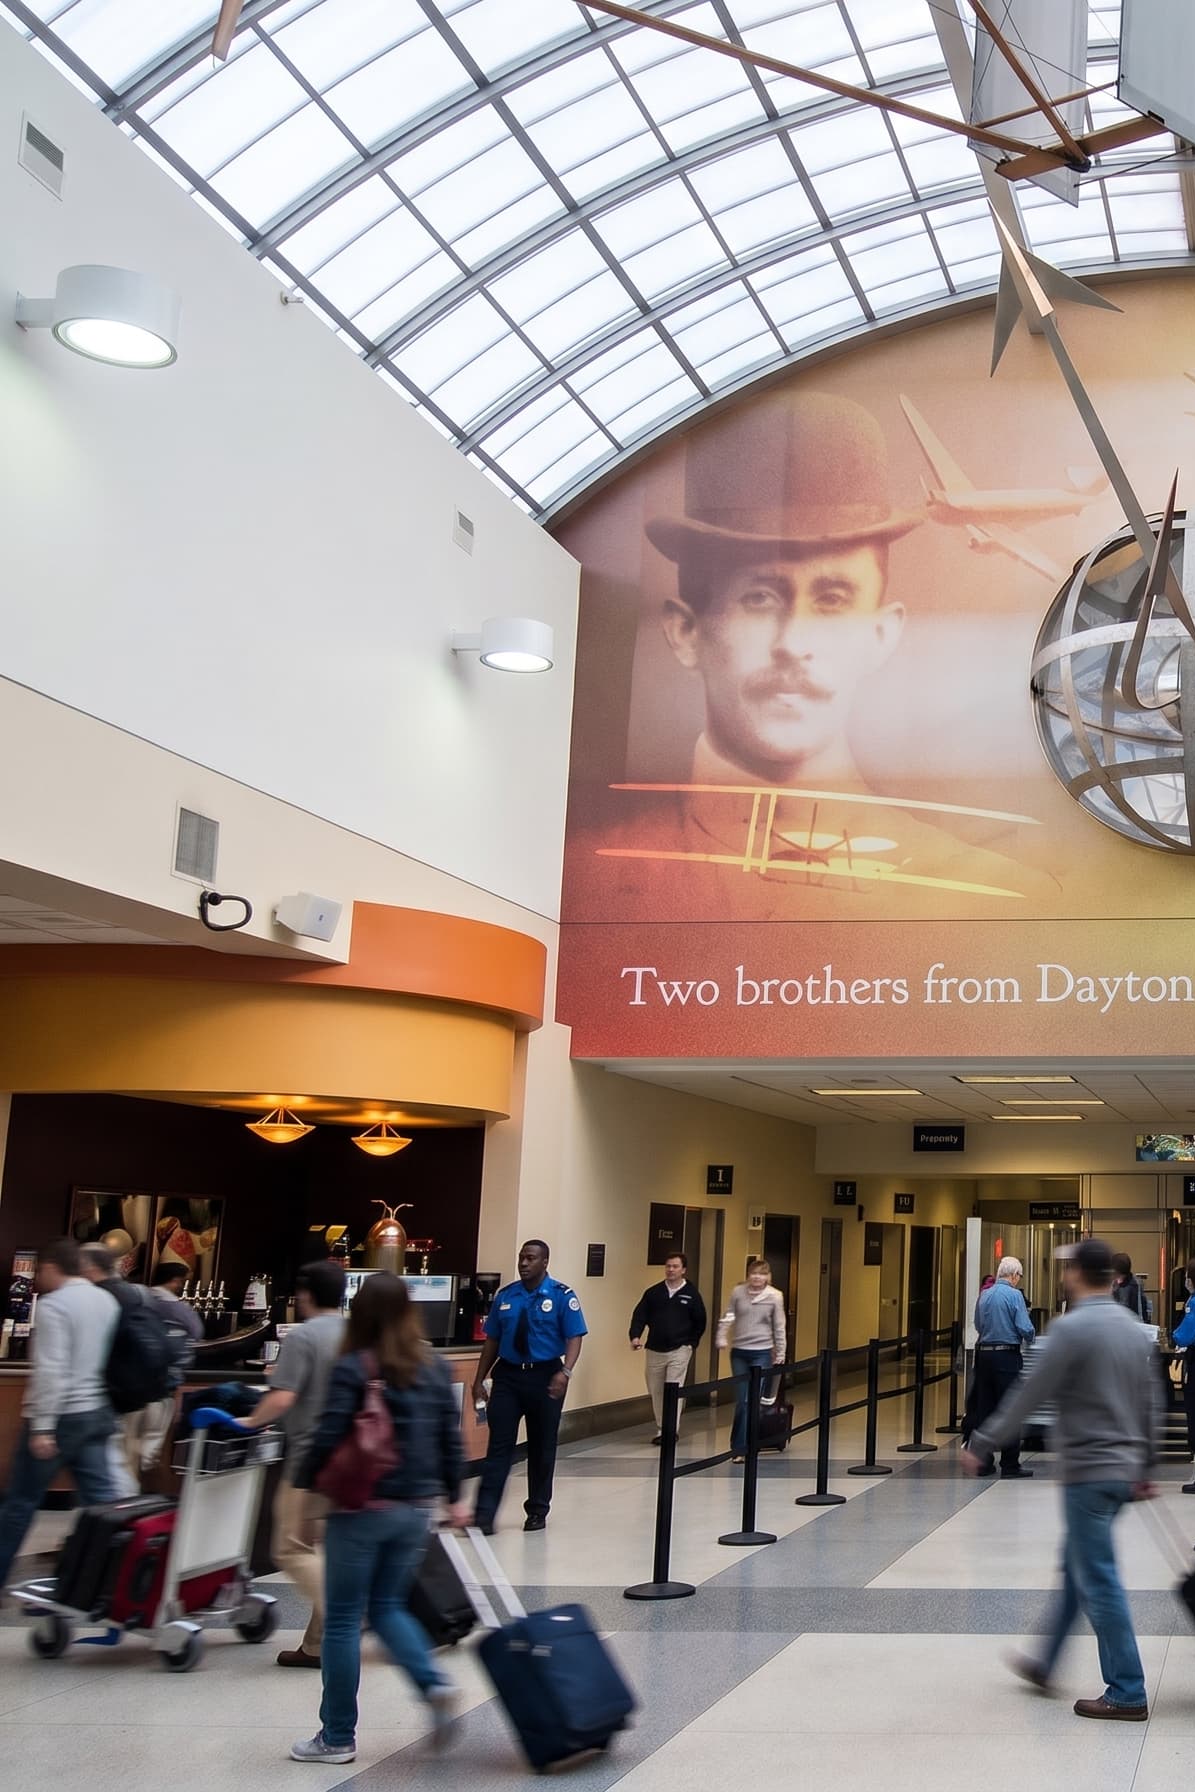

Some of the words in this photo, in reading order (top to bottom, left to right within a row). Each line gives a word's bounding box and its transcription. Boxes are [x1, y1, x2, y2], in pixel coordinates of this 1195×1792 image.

[620, 966, 720, 1007] Two
[734, 963, 910, 1006] brothers
[923, 962, 1023, 1004] from
